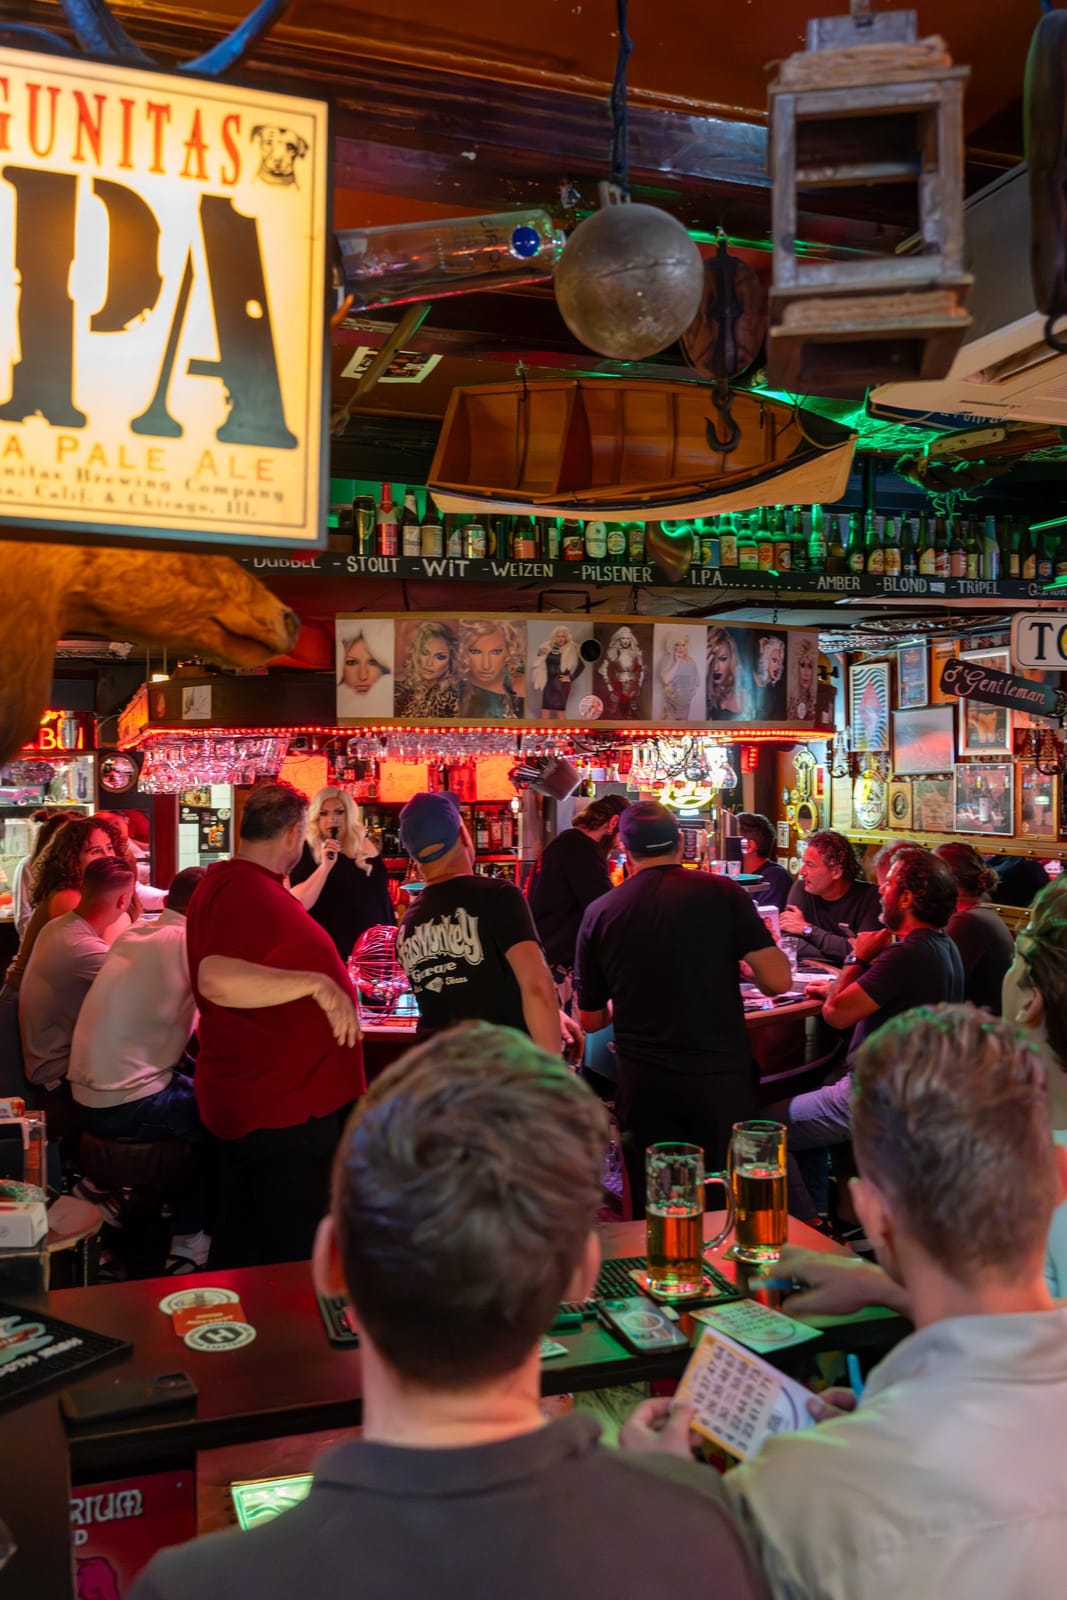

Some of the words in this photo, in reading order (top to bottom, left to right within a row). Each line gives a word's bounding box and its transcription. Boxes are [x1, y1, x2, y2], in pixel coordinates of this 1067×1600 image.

[55, 435, 166, 472] PALE
[195, 447, 274, 482] ALE
[185, 477, 284, 503] Company
[347, 554, 400, 573] STOUT
[816, 575, 860, 590] AMBER
[883, 577, 927, 593] BLOND
